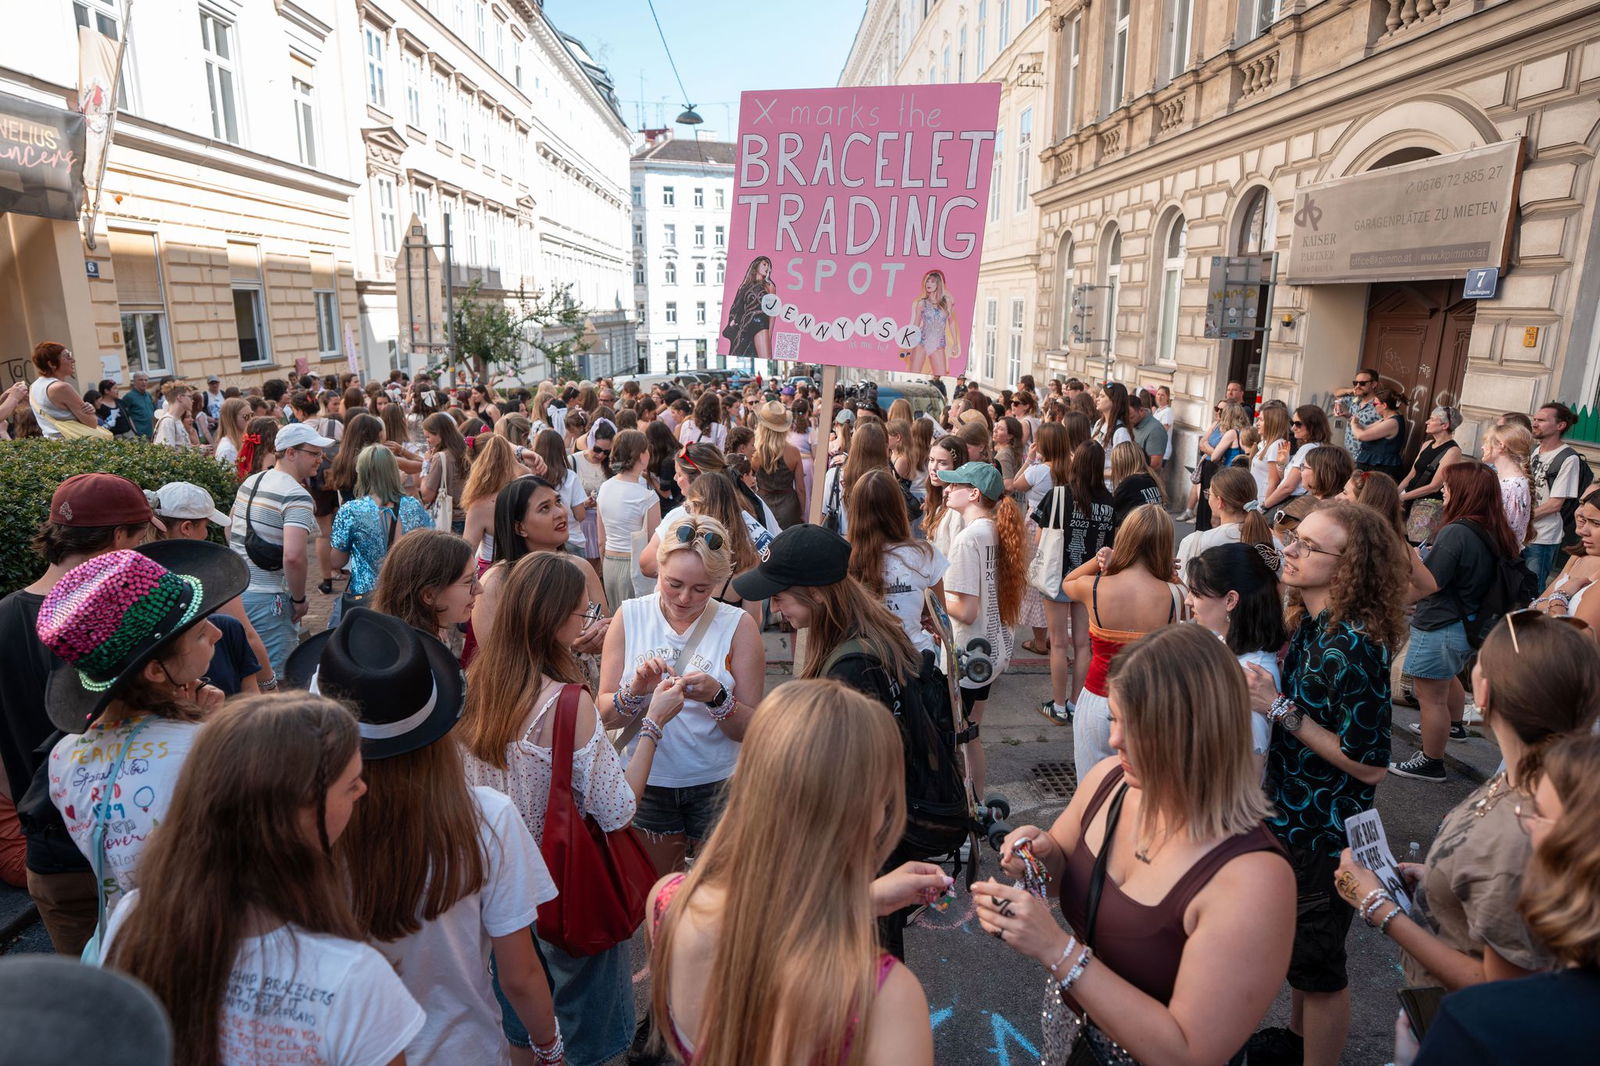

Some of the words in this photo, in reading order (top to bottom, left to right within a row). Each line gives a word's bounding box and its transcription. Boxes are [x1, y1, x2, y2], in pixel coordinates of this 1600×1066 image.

[753, 98, 777, 125] X
[790, 95, 881, 129] marks
[900, 93, 942, 128] the
[740, 131, 996, 189] BRACELET
[1463, 168, 1484, 184] 885
[1488, 165, 1503, 181] 27
[738, 193, 979, 260] TRADING
[1354, 209, 1430, 232] GARAGENPLÄTZE
[1434, 207, 1449, 221] ZU
[1453, 201, 1498, 219] MIETEN
[1302, 232, 1337, 248] KAISER
[87, 262, 95, 272] 6
[787, 258, 905, 297] SPOT
[1476, 271, 1487, 288] 7
[763, 297, 917, 348] JENNYYSK
[1069, 519, 1090, 529] 2023
